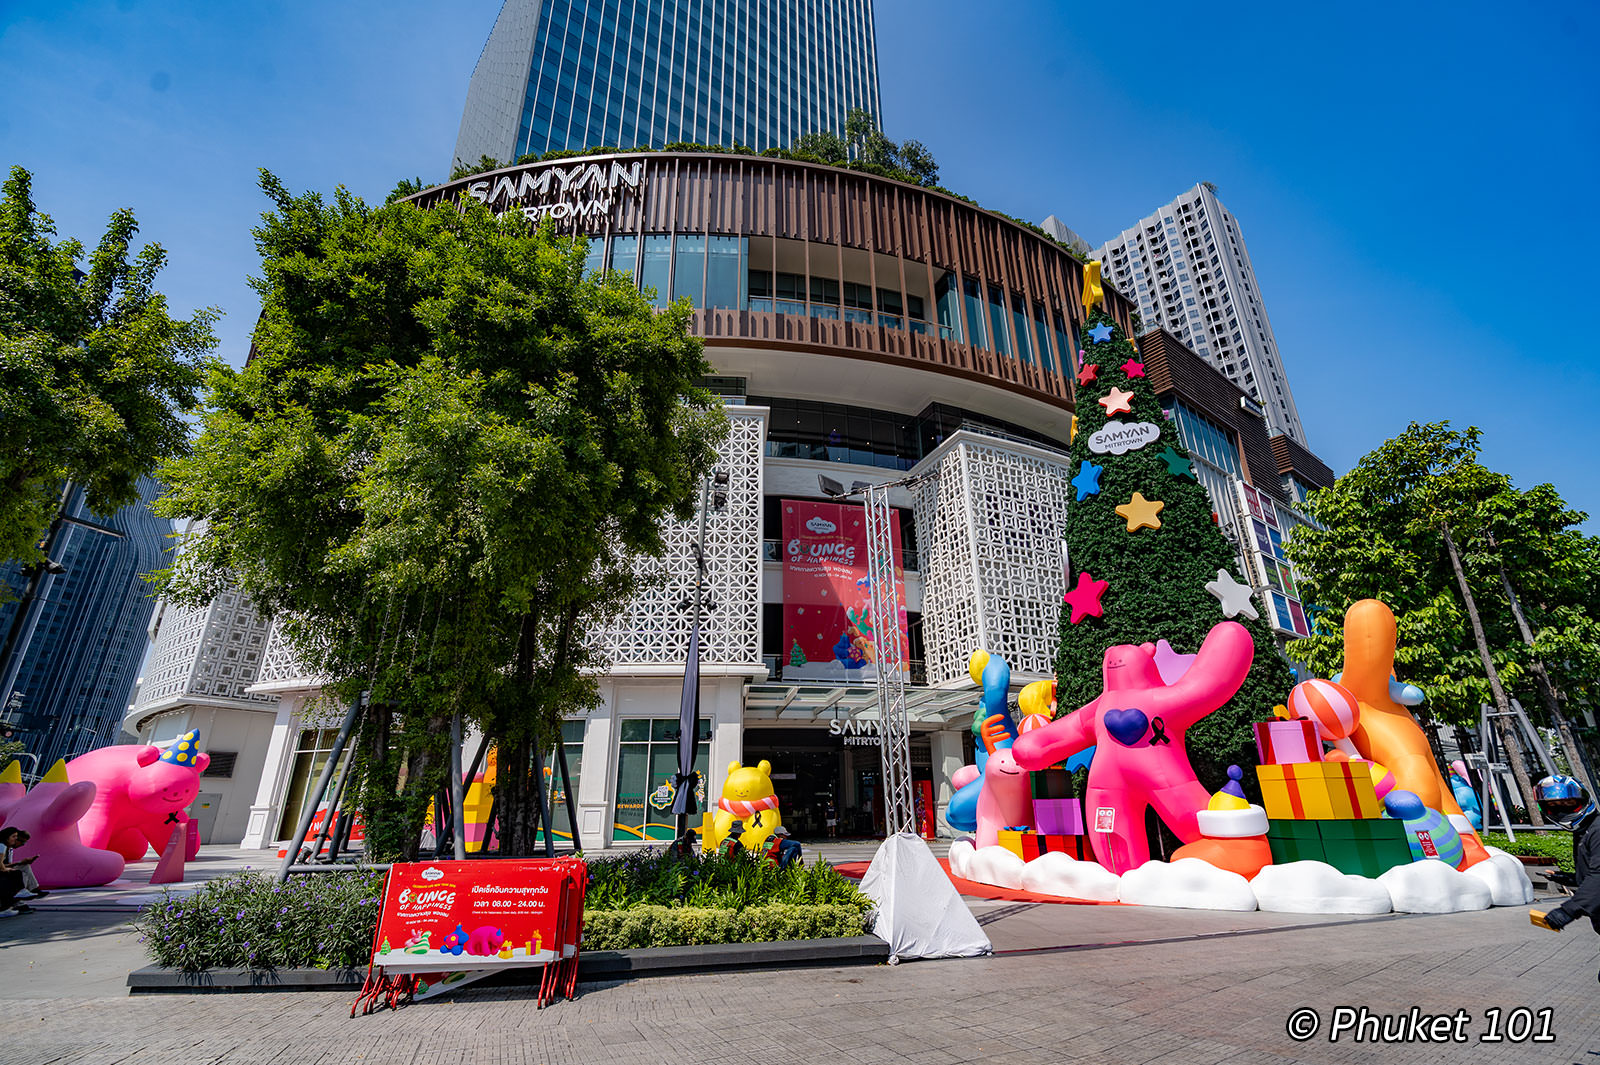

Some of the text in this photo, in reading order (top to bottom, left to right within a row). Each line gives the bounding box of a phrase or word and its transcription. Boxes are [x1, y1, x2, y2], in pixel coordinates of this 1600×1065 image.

[469, 161, 641, 205] SAMYAN
[1096, 426, 1149, 444] SAMYAN
[1105, 438, 1143, 449] MITRTOWN
[791, 555, 853, 566] OF HAPPINESS
[412, 902, 453, 911] HAPPINESS
[473, 900, 490, 908] เวลา
[518, 900, 537, 908] 24.00
